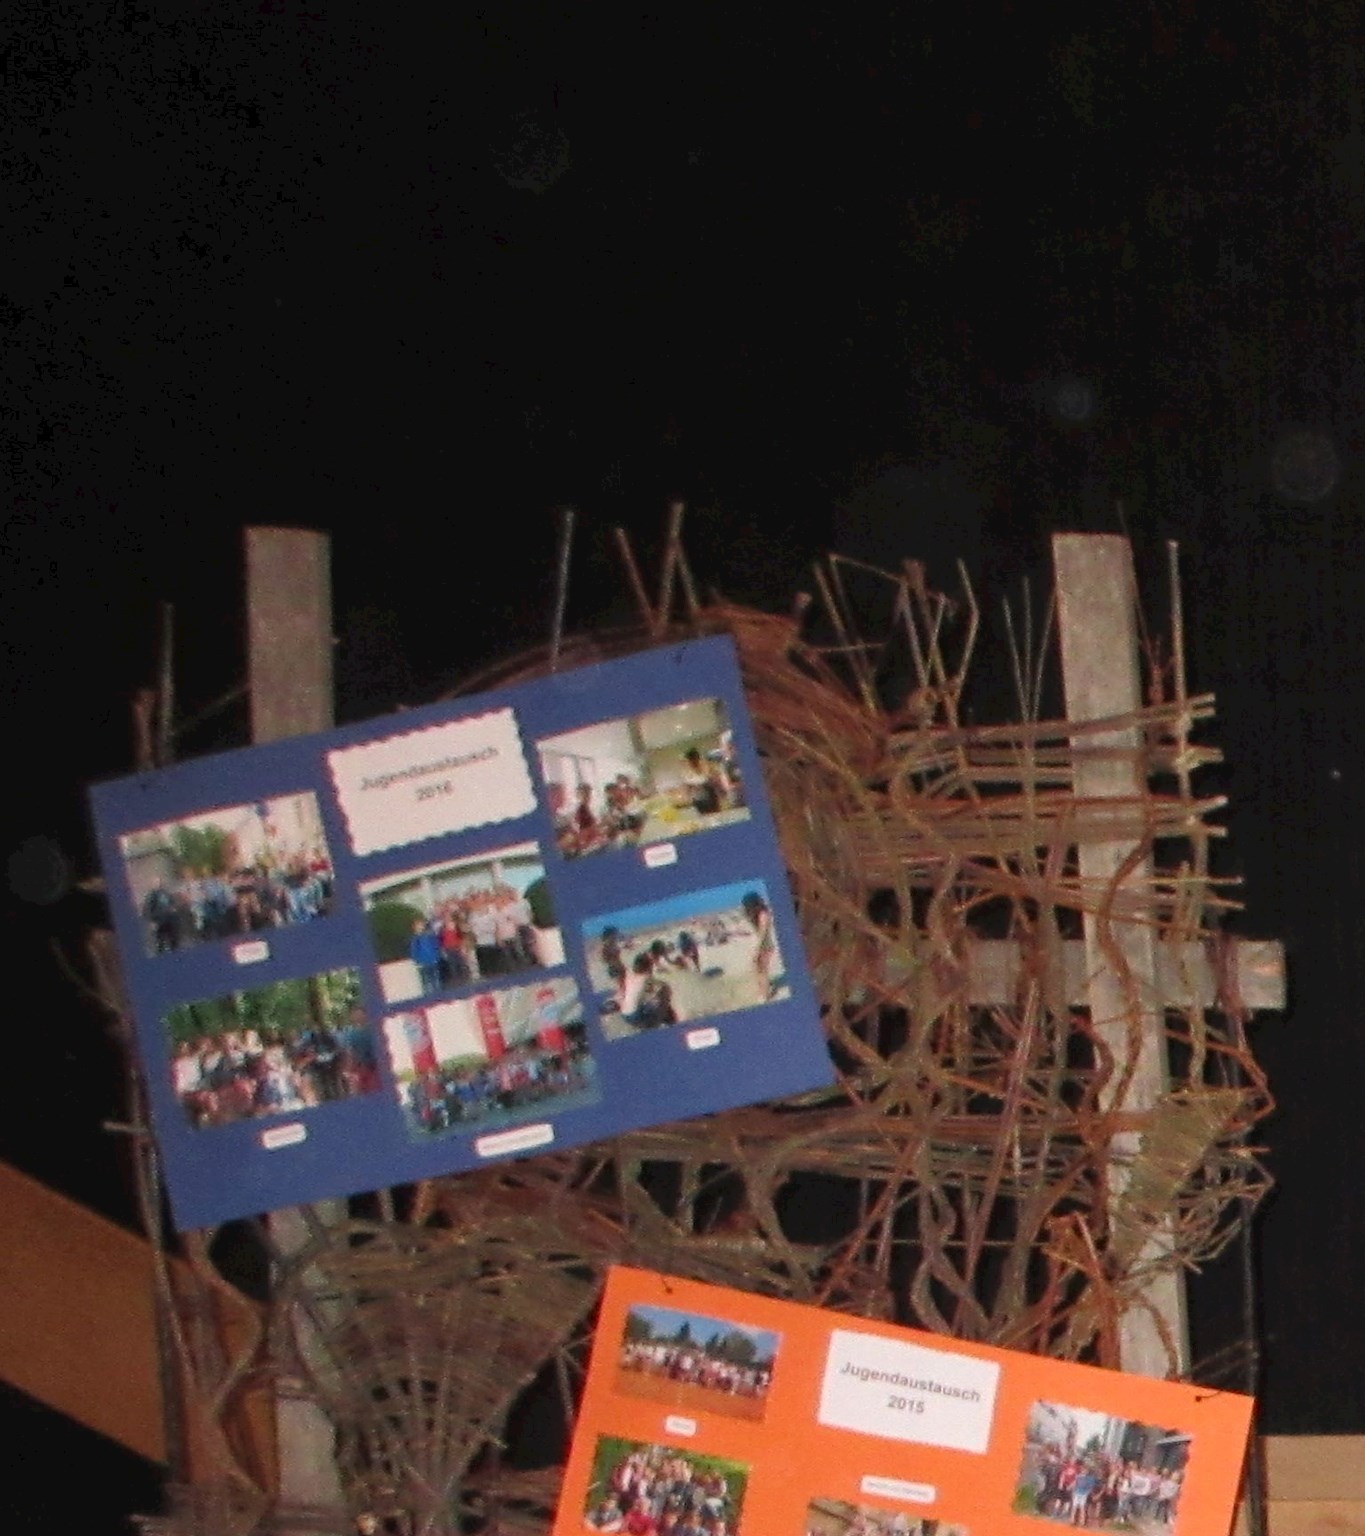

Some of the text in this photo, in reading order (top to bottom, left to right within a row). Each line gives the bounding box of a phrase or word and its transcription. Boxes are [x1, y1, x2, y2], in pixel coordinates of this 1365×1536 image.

[361, 746, 499, 791] Jugendaustausch
[416, 780, 453, 801] 2016
[839, 1362, 981, 1402] Jugendaustausch
[888, 1395, 925, 1414] 2015
